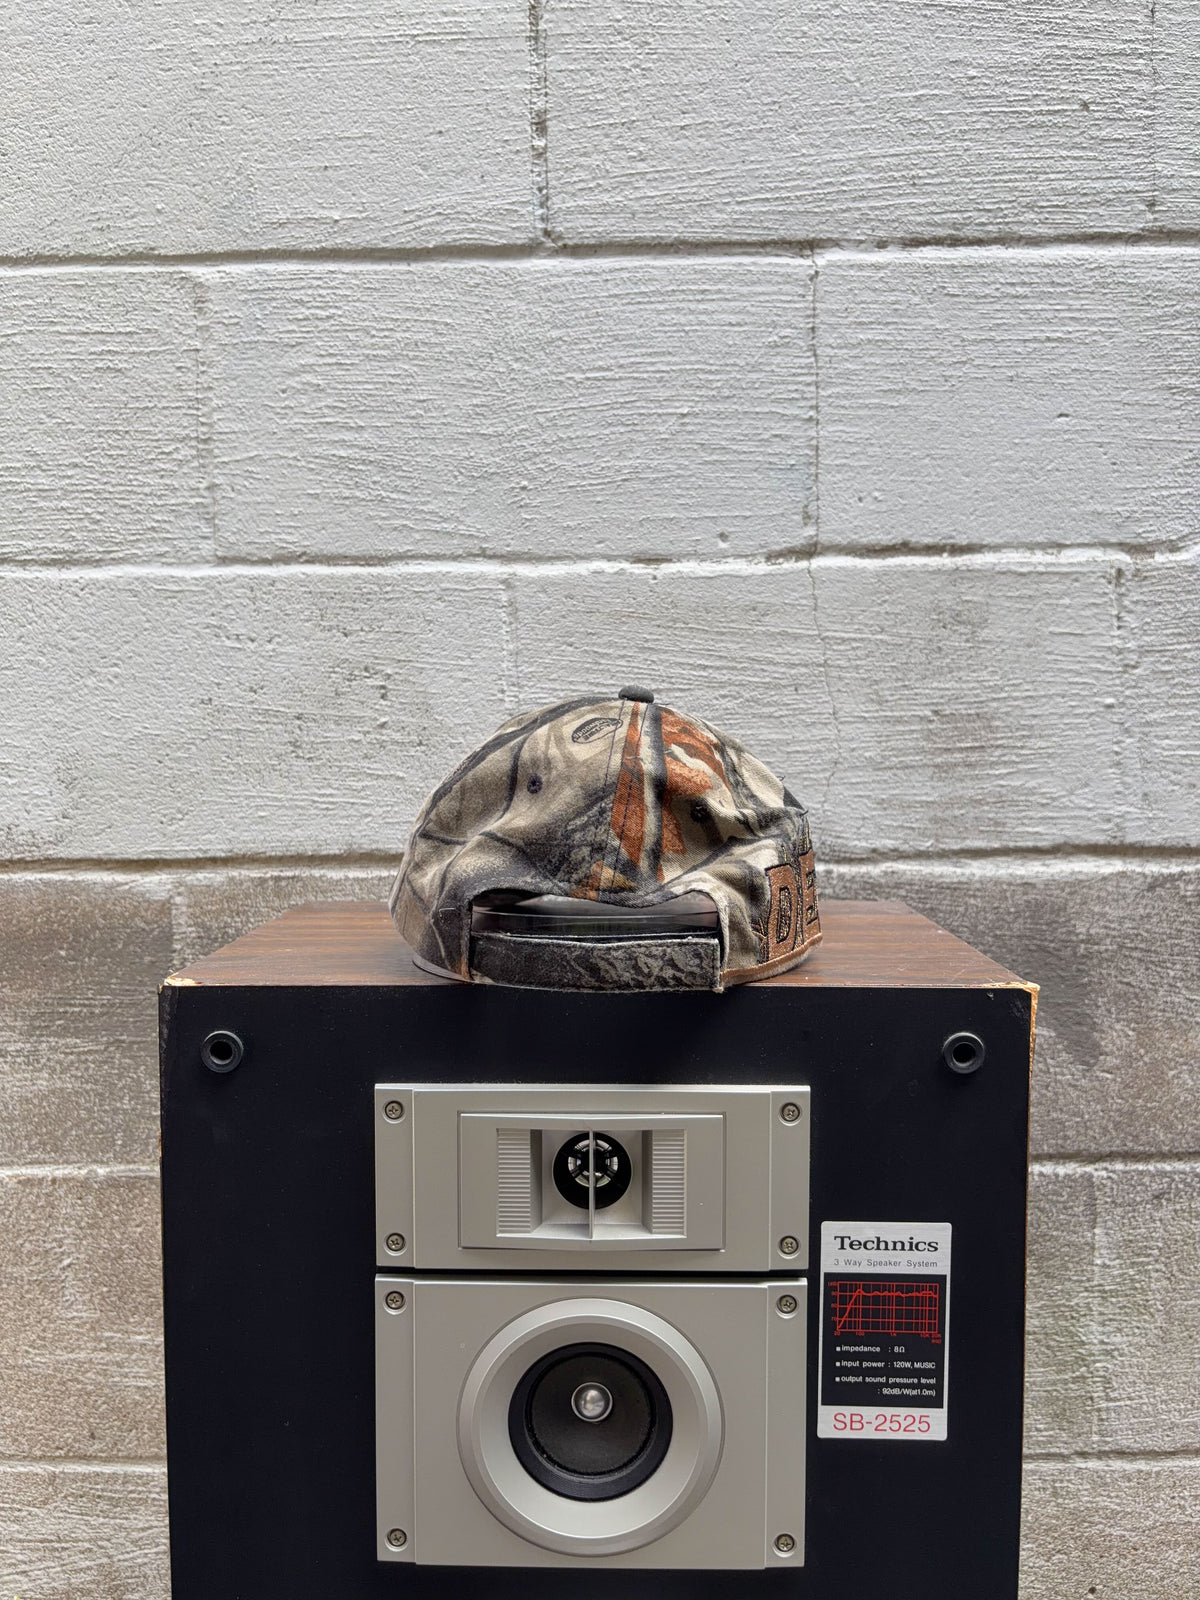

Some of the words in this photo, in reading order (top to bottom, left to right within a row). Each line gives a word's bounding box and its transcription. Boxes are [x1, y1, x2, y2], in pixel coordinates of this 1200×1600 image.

[833, 1235, 939, 1253] Technics
[833, 1258, 840, 1266] 3
[843, 1258, 862, 1269] Way
[866, 1259, 902, 1269] Speaker
[906, 1260, 938, 1269] System
[841, 1345, 880, 1353] impedance
[841, 1360, 860, 1368] input
[862, 1361, 885, 1369] power
[833, 1412, 931, 1433] SB-2525
